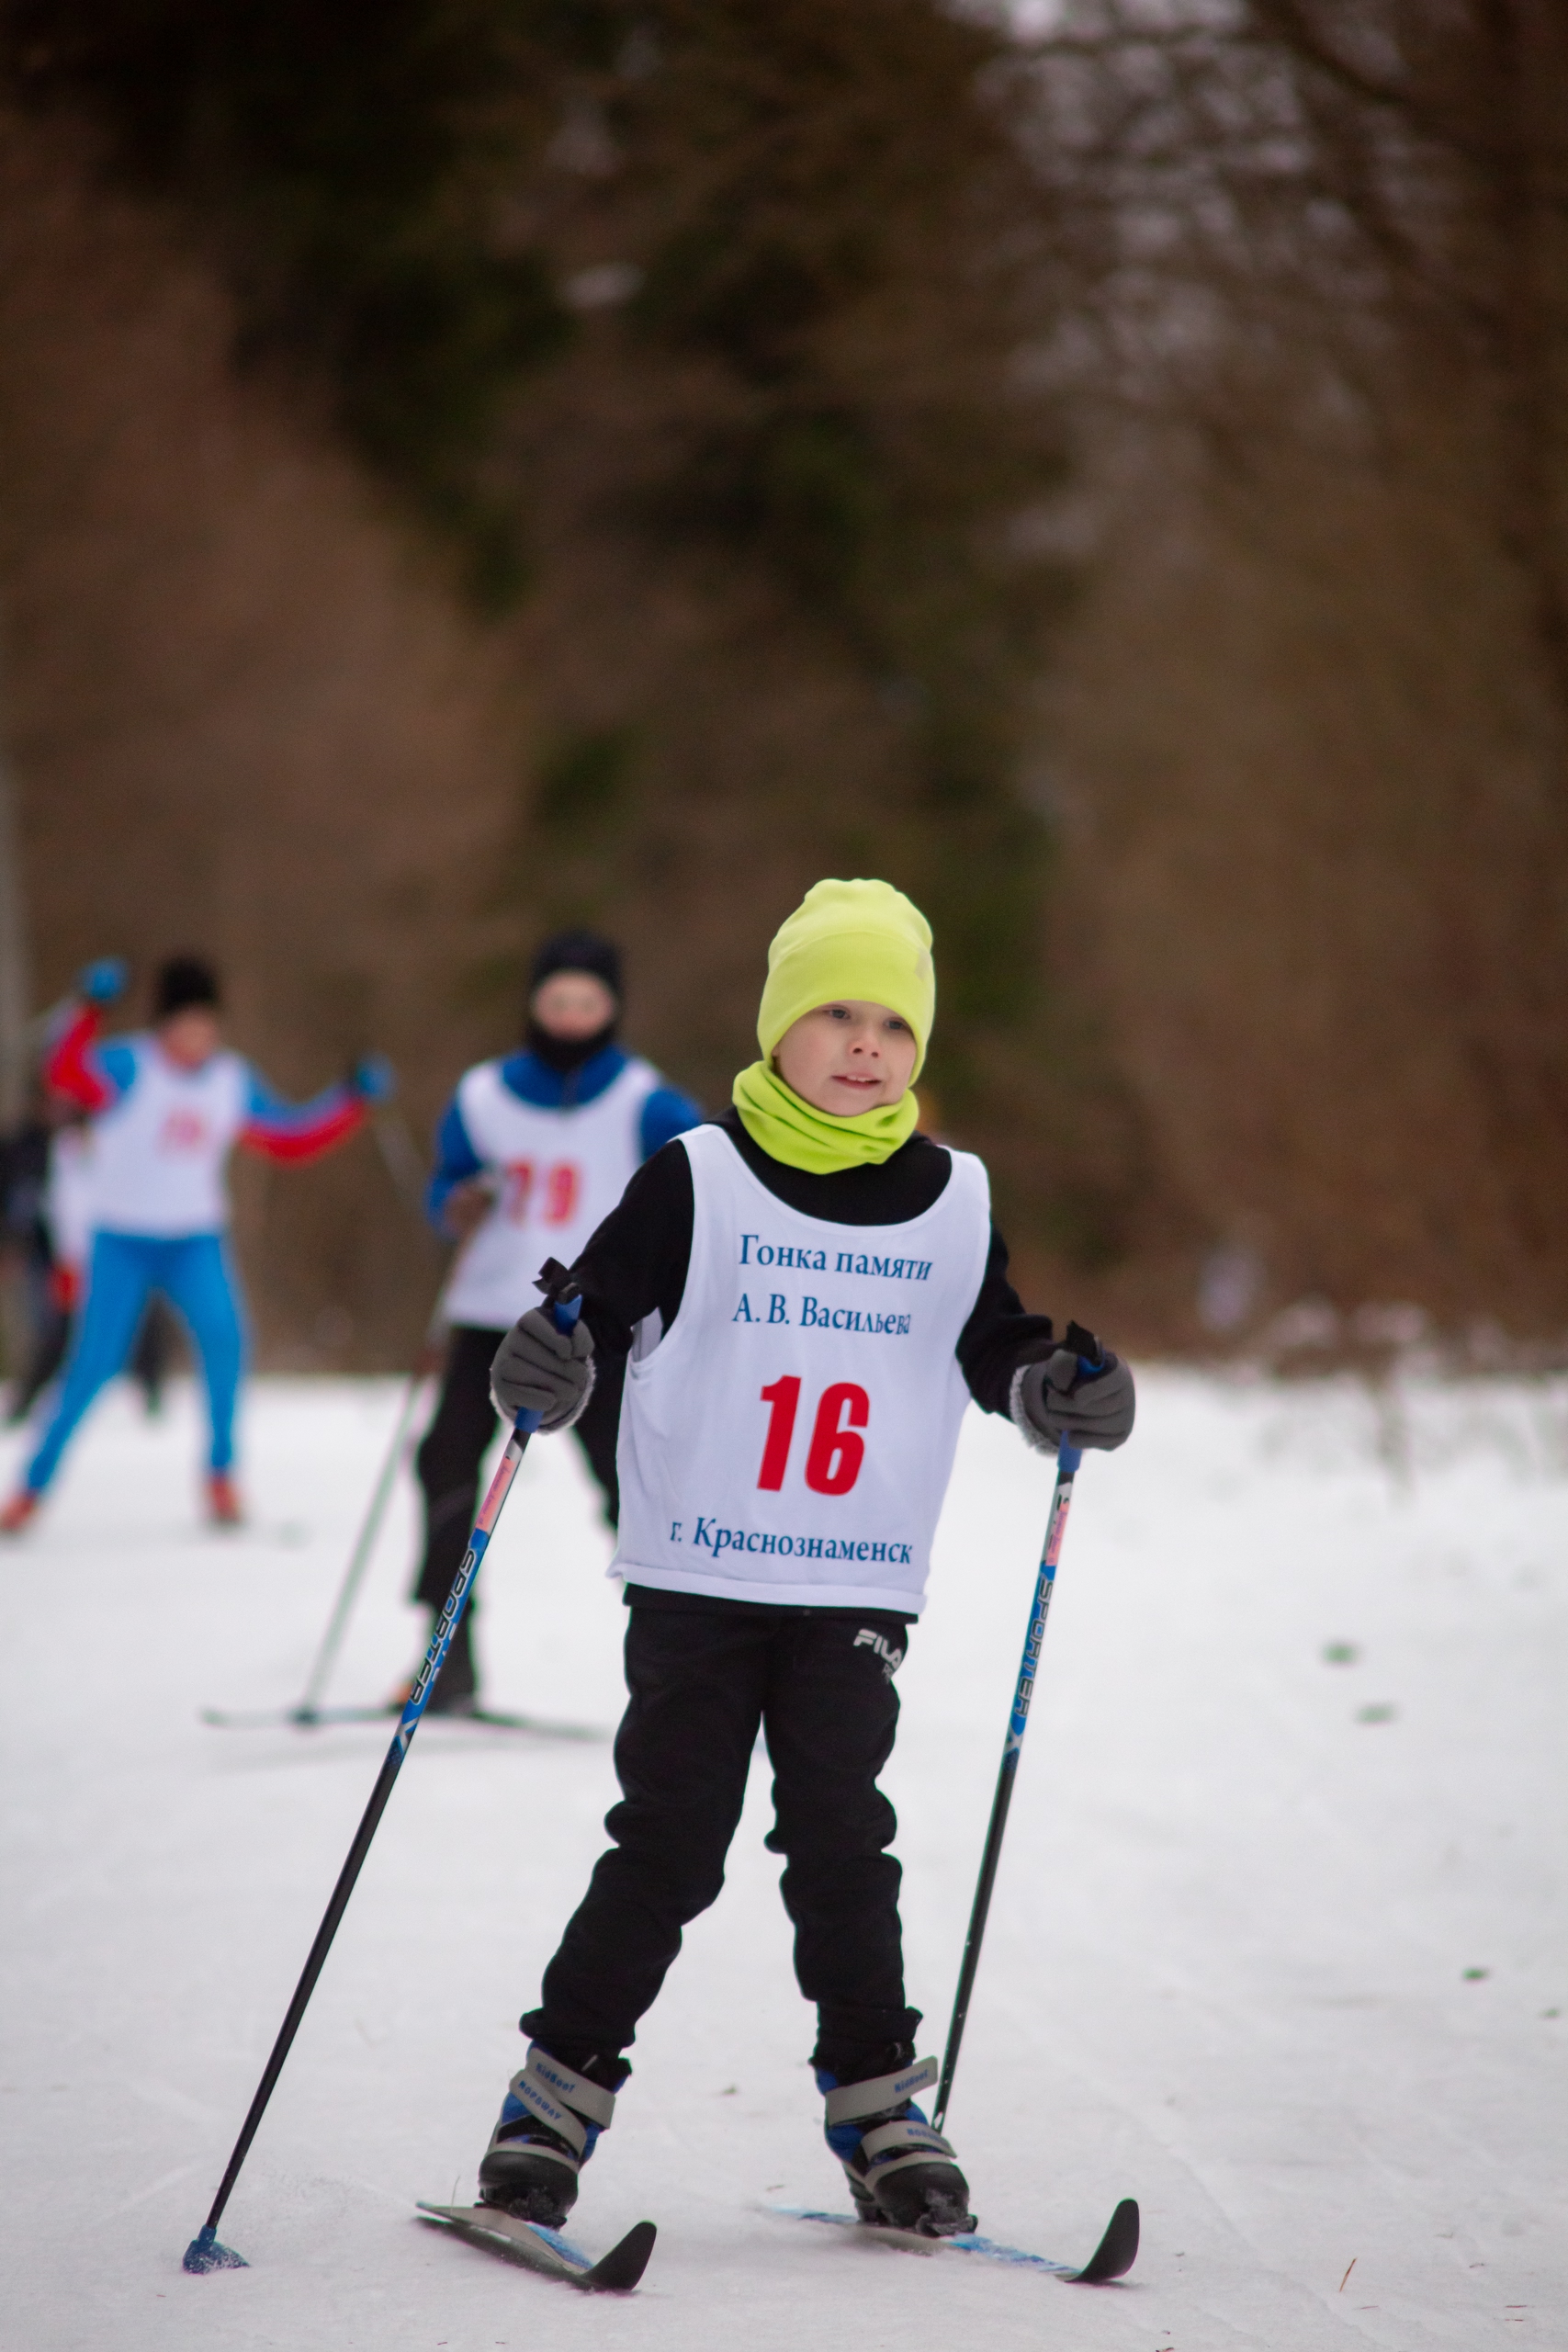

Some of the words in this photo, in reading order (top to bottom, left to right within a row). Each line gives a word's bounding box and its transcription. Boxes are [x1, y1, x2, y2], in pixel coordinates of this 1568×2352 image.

[738, 1234, 827, 1271] Гонка
[835, 1252, 933, 1282] памяти
[798, 1296, 911, 1336] Васильева
[757, 1374, 870, 1497] 16
[669, 1521, 682, 1544] г.
[692, 1517, 913, 1566] Краснознаменск
[410, 1549, 476, 1705] SPORTER
[852, 1628, 902, 1670] FILA
[1015, 1579, 1054, 1716] SPORTER
